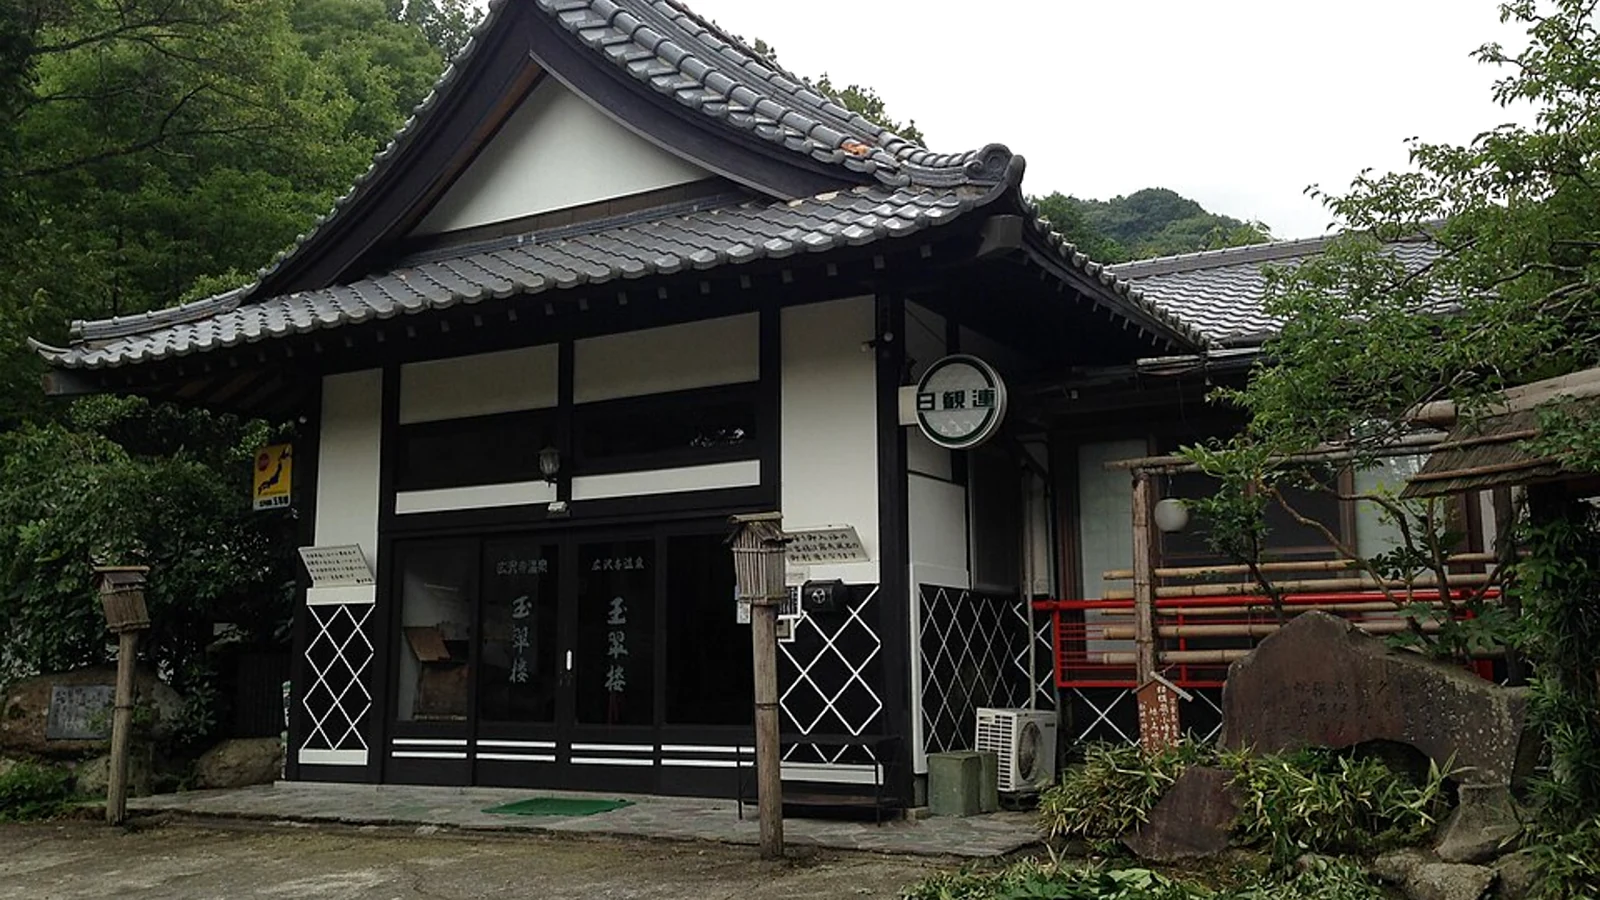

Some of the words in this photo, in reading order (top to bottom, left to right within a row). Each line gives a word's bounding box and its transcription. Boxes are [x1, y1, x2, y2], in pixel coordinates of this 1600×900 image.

[916, 389, 996, 411] 日観連
[509, 596, 533, 684] 玉翠楼
[604, 597, 629, 692] 玉翠楼
